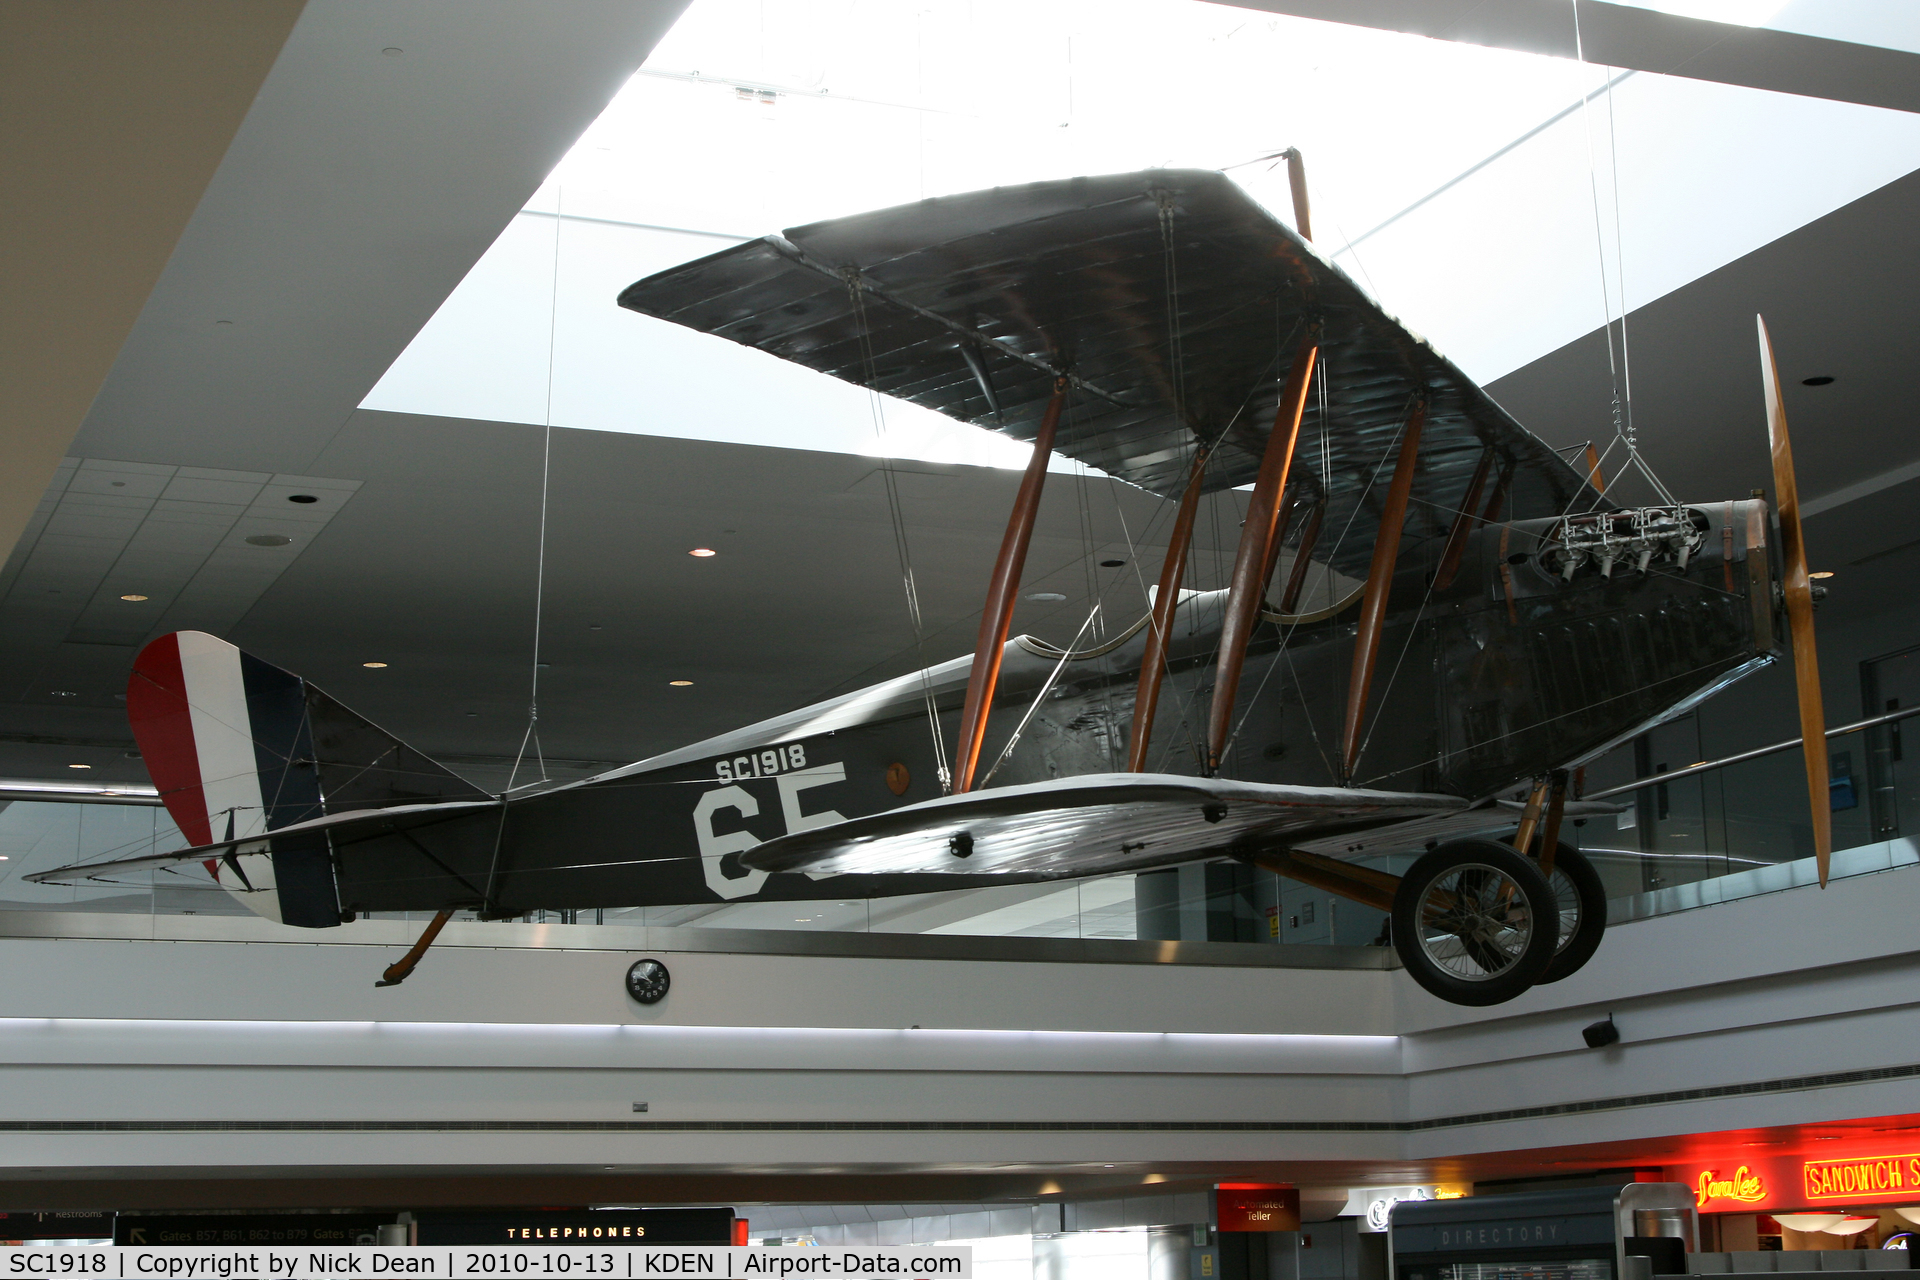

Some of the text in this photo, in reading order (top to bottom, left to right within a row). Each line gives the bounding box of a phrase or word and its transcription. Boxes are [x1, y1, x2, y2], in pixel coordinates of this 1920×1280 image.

[715, 744, 806, 785] SC1918
[693, 761, 849, 901] 65
[1810, 1161, 1902, 1194] SANDWICH
[1233, 1201, 1284, 1209] Automated
[56, 1211, 102, 1219] Restrooms
[1246, 1211, 1271, 1221] Teller
[159, 1231, 190, 1241] Gates
[196, 1230, 219, 1242] B57,
[250, 1230, 269, 1240] B62
[273, 1230, 285, 1240] to
[287, 1229, 308, 1239] B79
[313, 1229, 344, 1239] Gates
[507, 1227, 645, 1239] TELEPHONES
[1442, 1224, 1557, 1245] DIRECTORY
